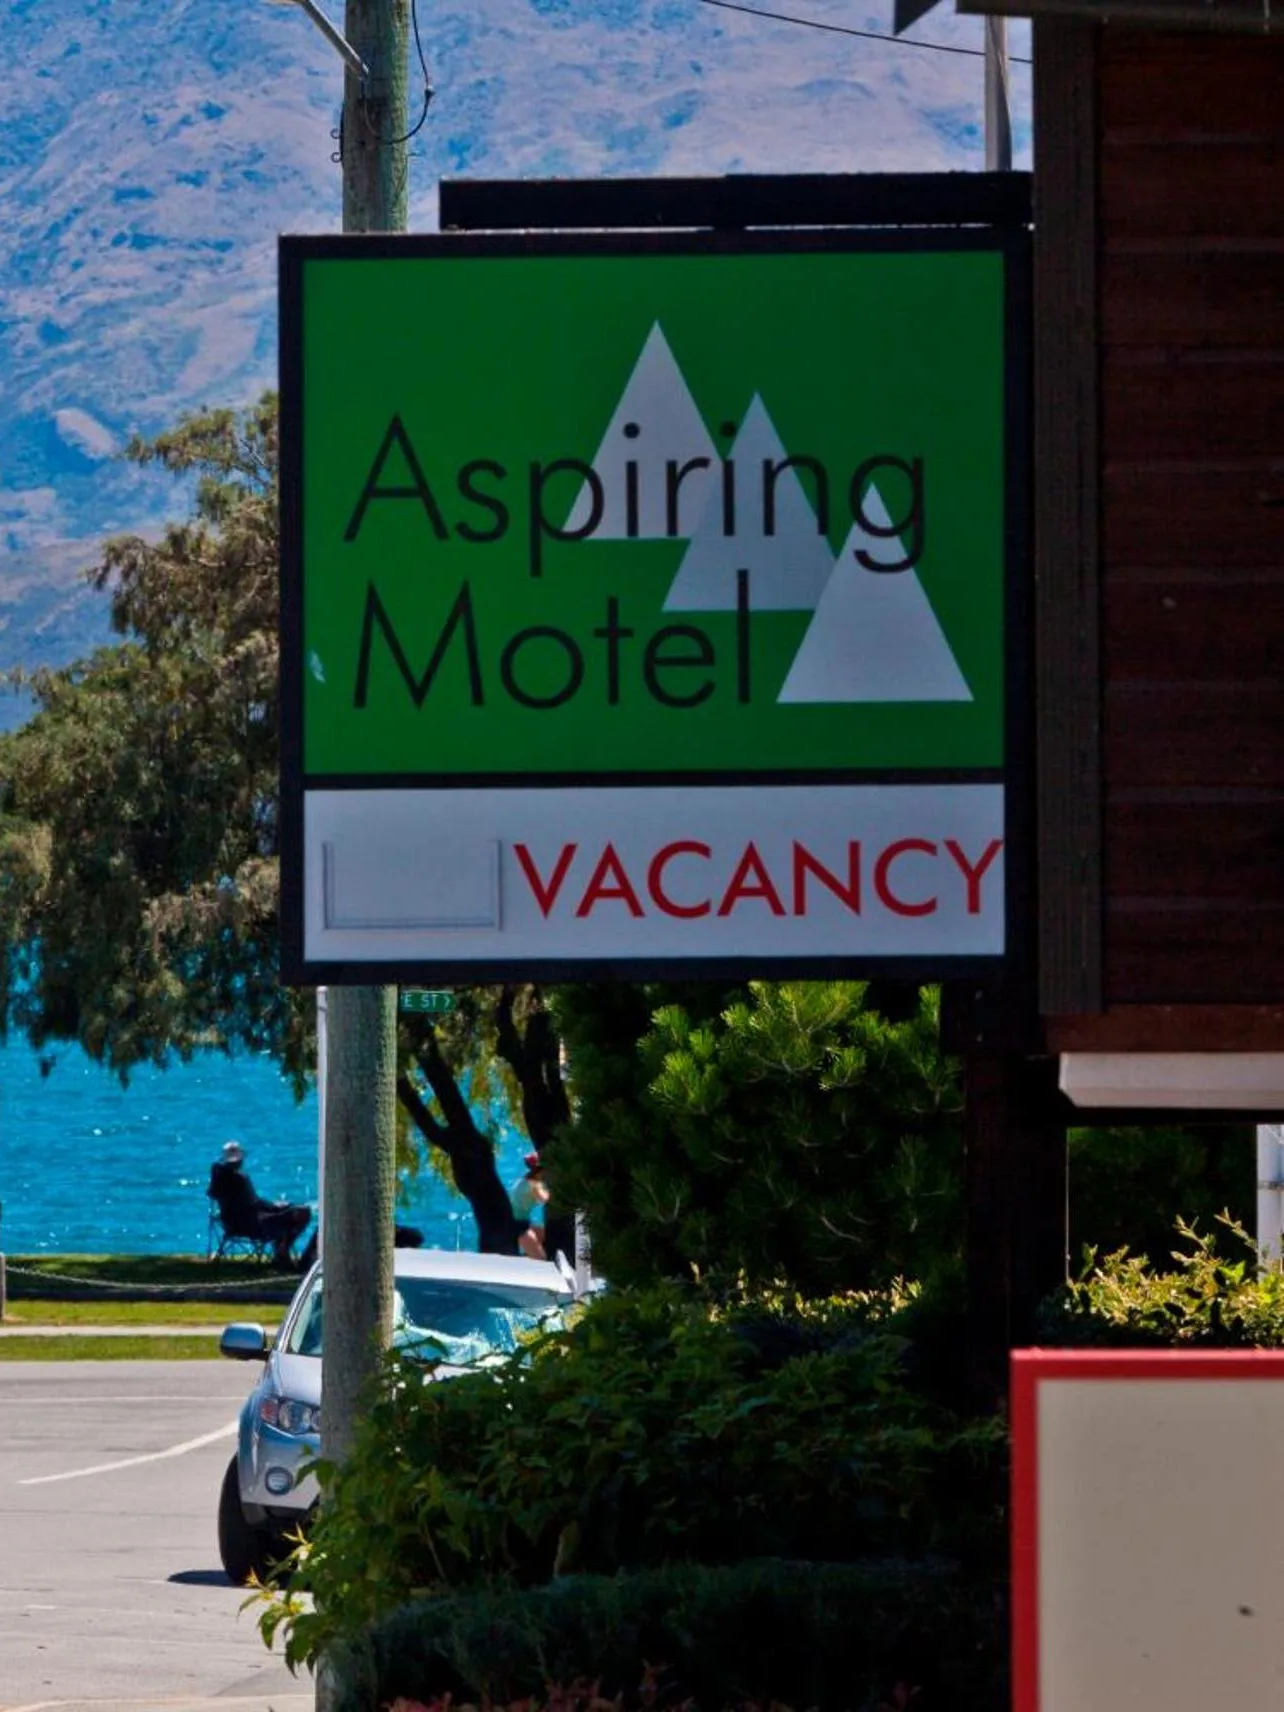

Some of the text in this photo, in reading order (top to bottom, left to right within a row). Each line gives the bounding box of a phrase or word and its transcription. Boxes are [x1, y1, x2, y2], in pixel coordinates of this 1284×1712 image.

[342, 411, 925, 578] Aspiring
[353, 568, 750, 710] Motel
[513, 837, 1004, 919] VACANCY
[420, 993, 439, 1009] ST
